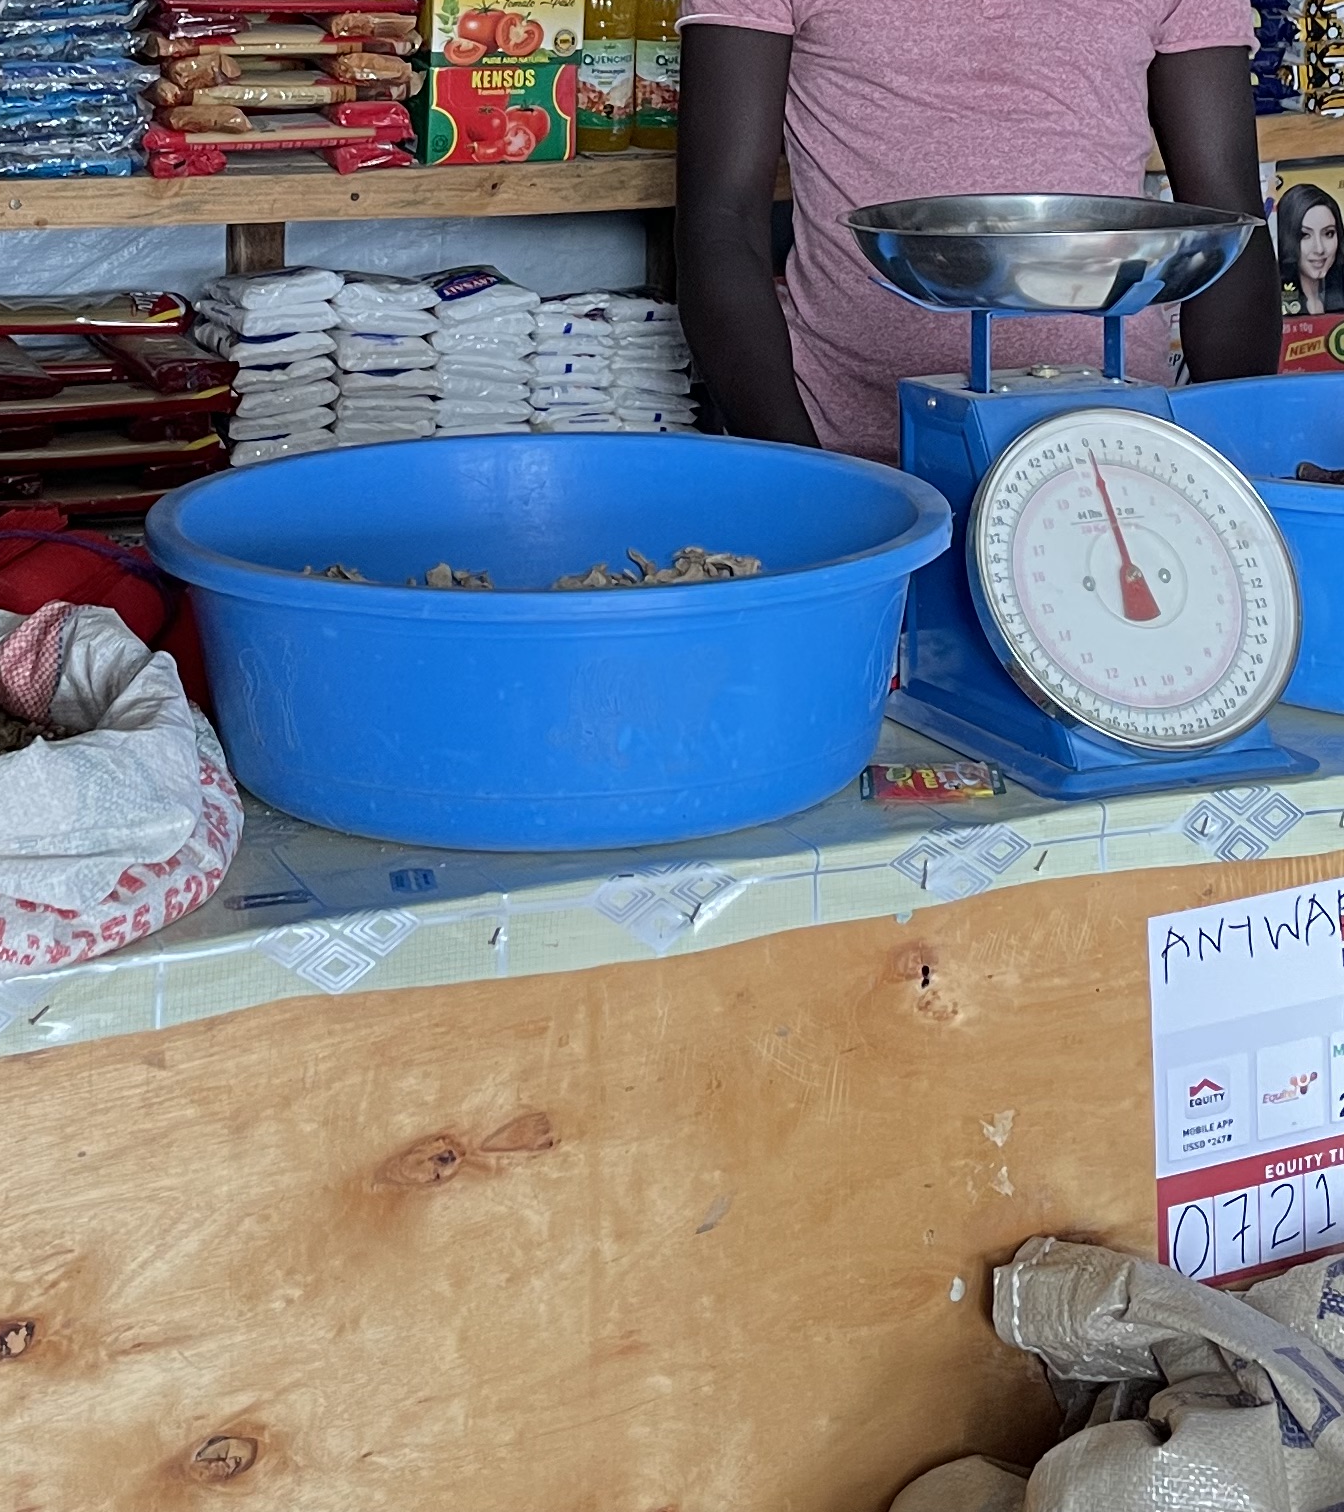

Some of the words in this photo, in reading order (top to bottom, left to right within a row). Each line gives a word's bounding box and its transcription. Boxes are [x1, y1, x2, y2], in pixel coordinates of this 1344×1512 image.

[471, 69, 536, 89] KENSOS
[1289, 341, 1322, 357] NEW!
[1057, 443, 1070, 453] 44
[1081, 437, 1089, 448] 0
[1100, 439, 1107, 448] 1
[1116, 440, 1125, 450] 2
[1042, 449, 1056, 460] 43
[1135, 445, 1143, 456] 3
[1027, 457, 1042, 468] 42
[1170, 463, 1178, 474] 5
[1015, 470, 1029, 481] 41
[1187, 473, 1195, 484] 6
[1005, 483, 1019, 494] 40
[1202, 489, 1210, 500] 7
[996, 499, 1010, 510] 39
[1217, 504, 1226, 515] 8
[1229, 519, 1238, 530] 9
[1236, 539, 1249, 550] 10
[1244, 557, 1258, 568] 11
[1250, 577, 1263, 588] 12
[1254, 597, 1268, 609] 13
[1255, 615, 1268, 627] 14
[1254, 633, 1268, 645] 15
[1250, 653, 1263, 665] 16
[1244, 670, 1256, 683] 17
[1234, 684, 1248, 697] 18
[1223, 697, 1236, 710] 19
[1211, 708, 1226, 720] 20
[1196, 717, 1211, 728] 21
[1180, 723, 1194, 735] 22
[1189, 1091, 1226, 1108] EQUITY
[1182, 1122, 1215, 1138] MOBILE
[1216, 1118, 1234, 1130] APP
[1182, 1139, 1206, 1153] USSD
[1265, 1153, 1325, 1180] EQUITY
